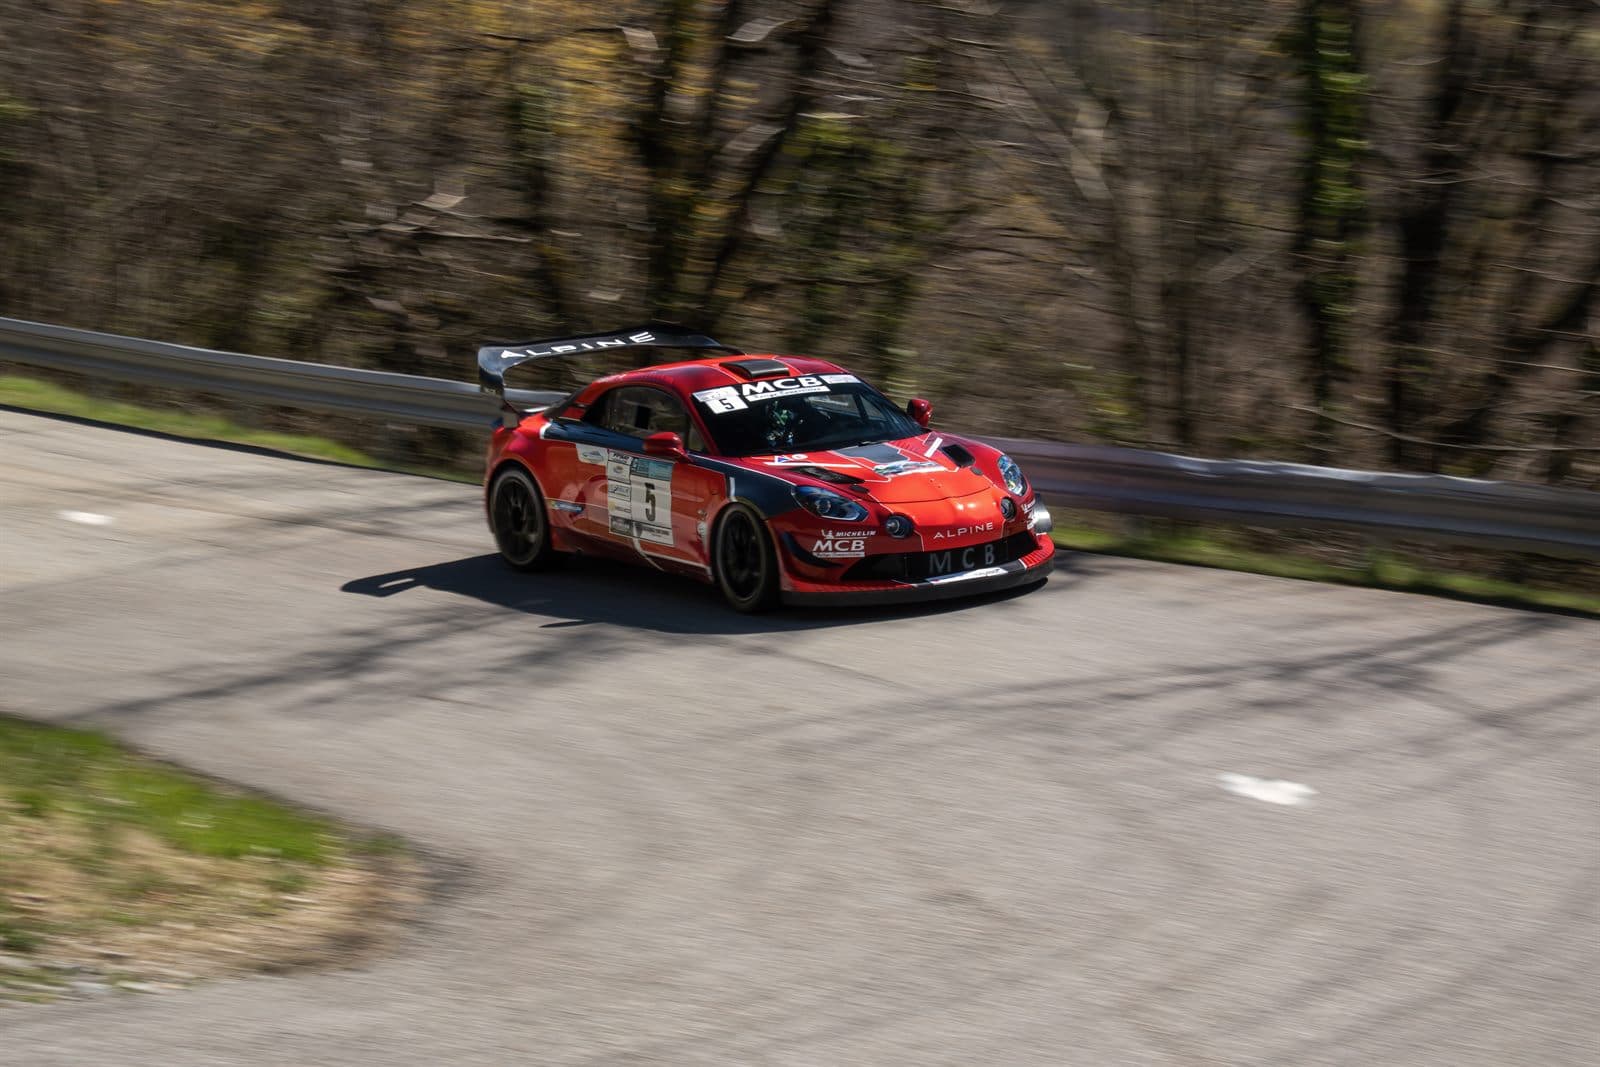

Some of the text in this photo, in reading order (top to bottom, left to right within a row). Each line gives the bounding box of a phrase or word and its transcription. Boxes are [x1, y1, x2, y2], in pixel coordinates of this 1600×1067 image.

[501, 331, 656, 359] ALPINE
[741, 377, 823, 396] MCB
[719, 398, 735, 410] 5
[645, 482, 656, 521] 5
[933, 522, 994, 540] ALPINE
[812, 540, 865, 551] MCB
